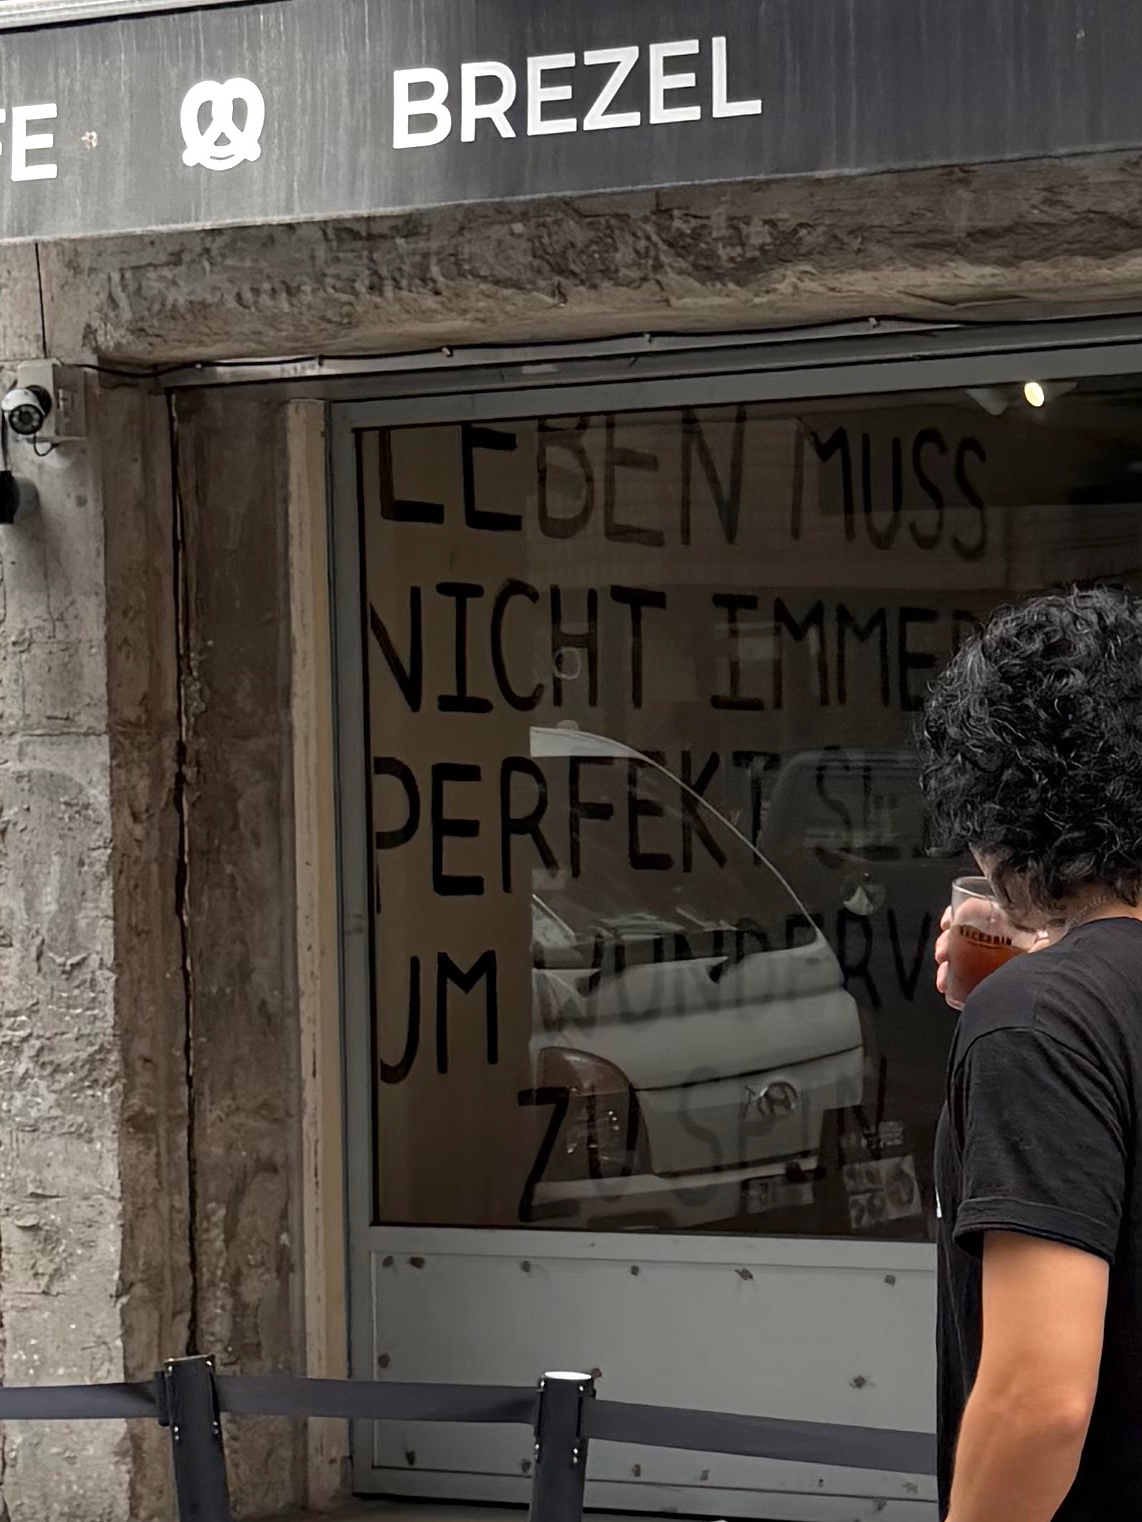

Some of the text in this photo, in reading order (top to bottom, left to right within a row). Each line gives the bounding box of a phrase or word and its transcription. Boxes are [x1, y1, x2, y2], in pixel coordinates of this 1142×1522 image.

[0, 103, 58, 182] E
[392, 36, 763, 149] BREZEL
[379, 406, 987, 560] LEBEN MUSS
[369, 579, 667, 713] NICHT
[373, 749, 782, 912] PERFEKT
